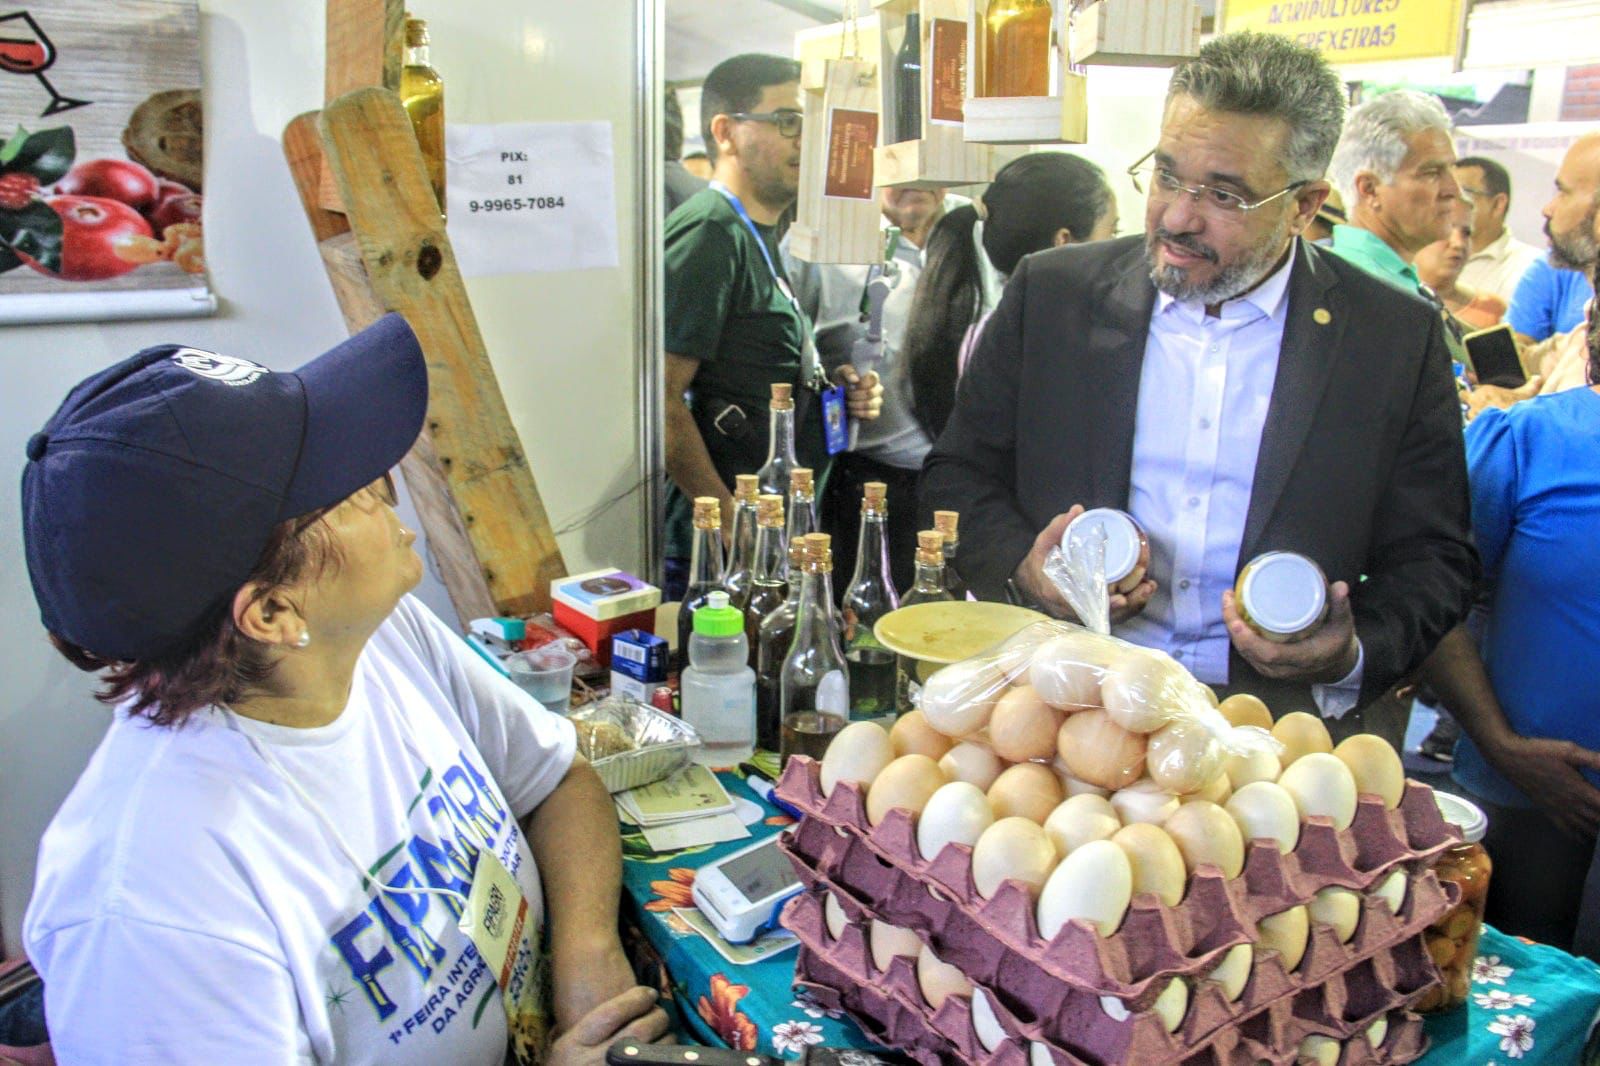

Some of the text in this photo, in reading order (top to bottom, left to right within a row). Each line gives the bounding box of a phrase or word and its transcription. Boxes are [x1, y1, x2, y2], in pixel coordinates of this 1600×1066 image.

[501, 152, 528, 163] PIX:
[508, 175, 523, 185] 81
[469, 196, 565, 213] 9-9965-7084
[403, 985, 451, 1034] FEIRA
[432, 1007, 457, 1035] DA
